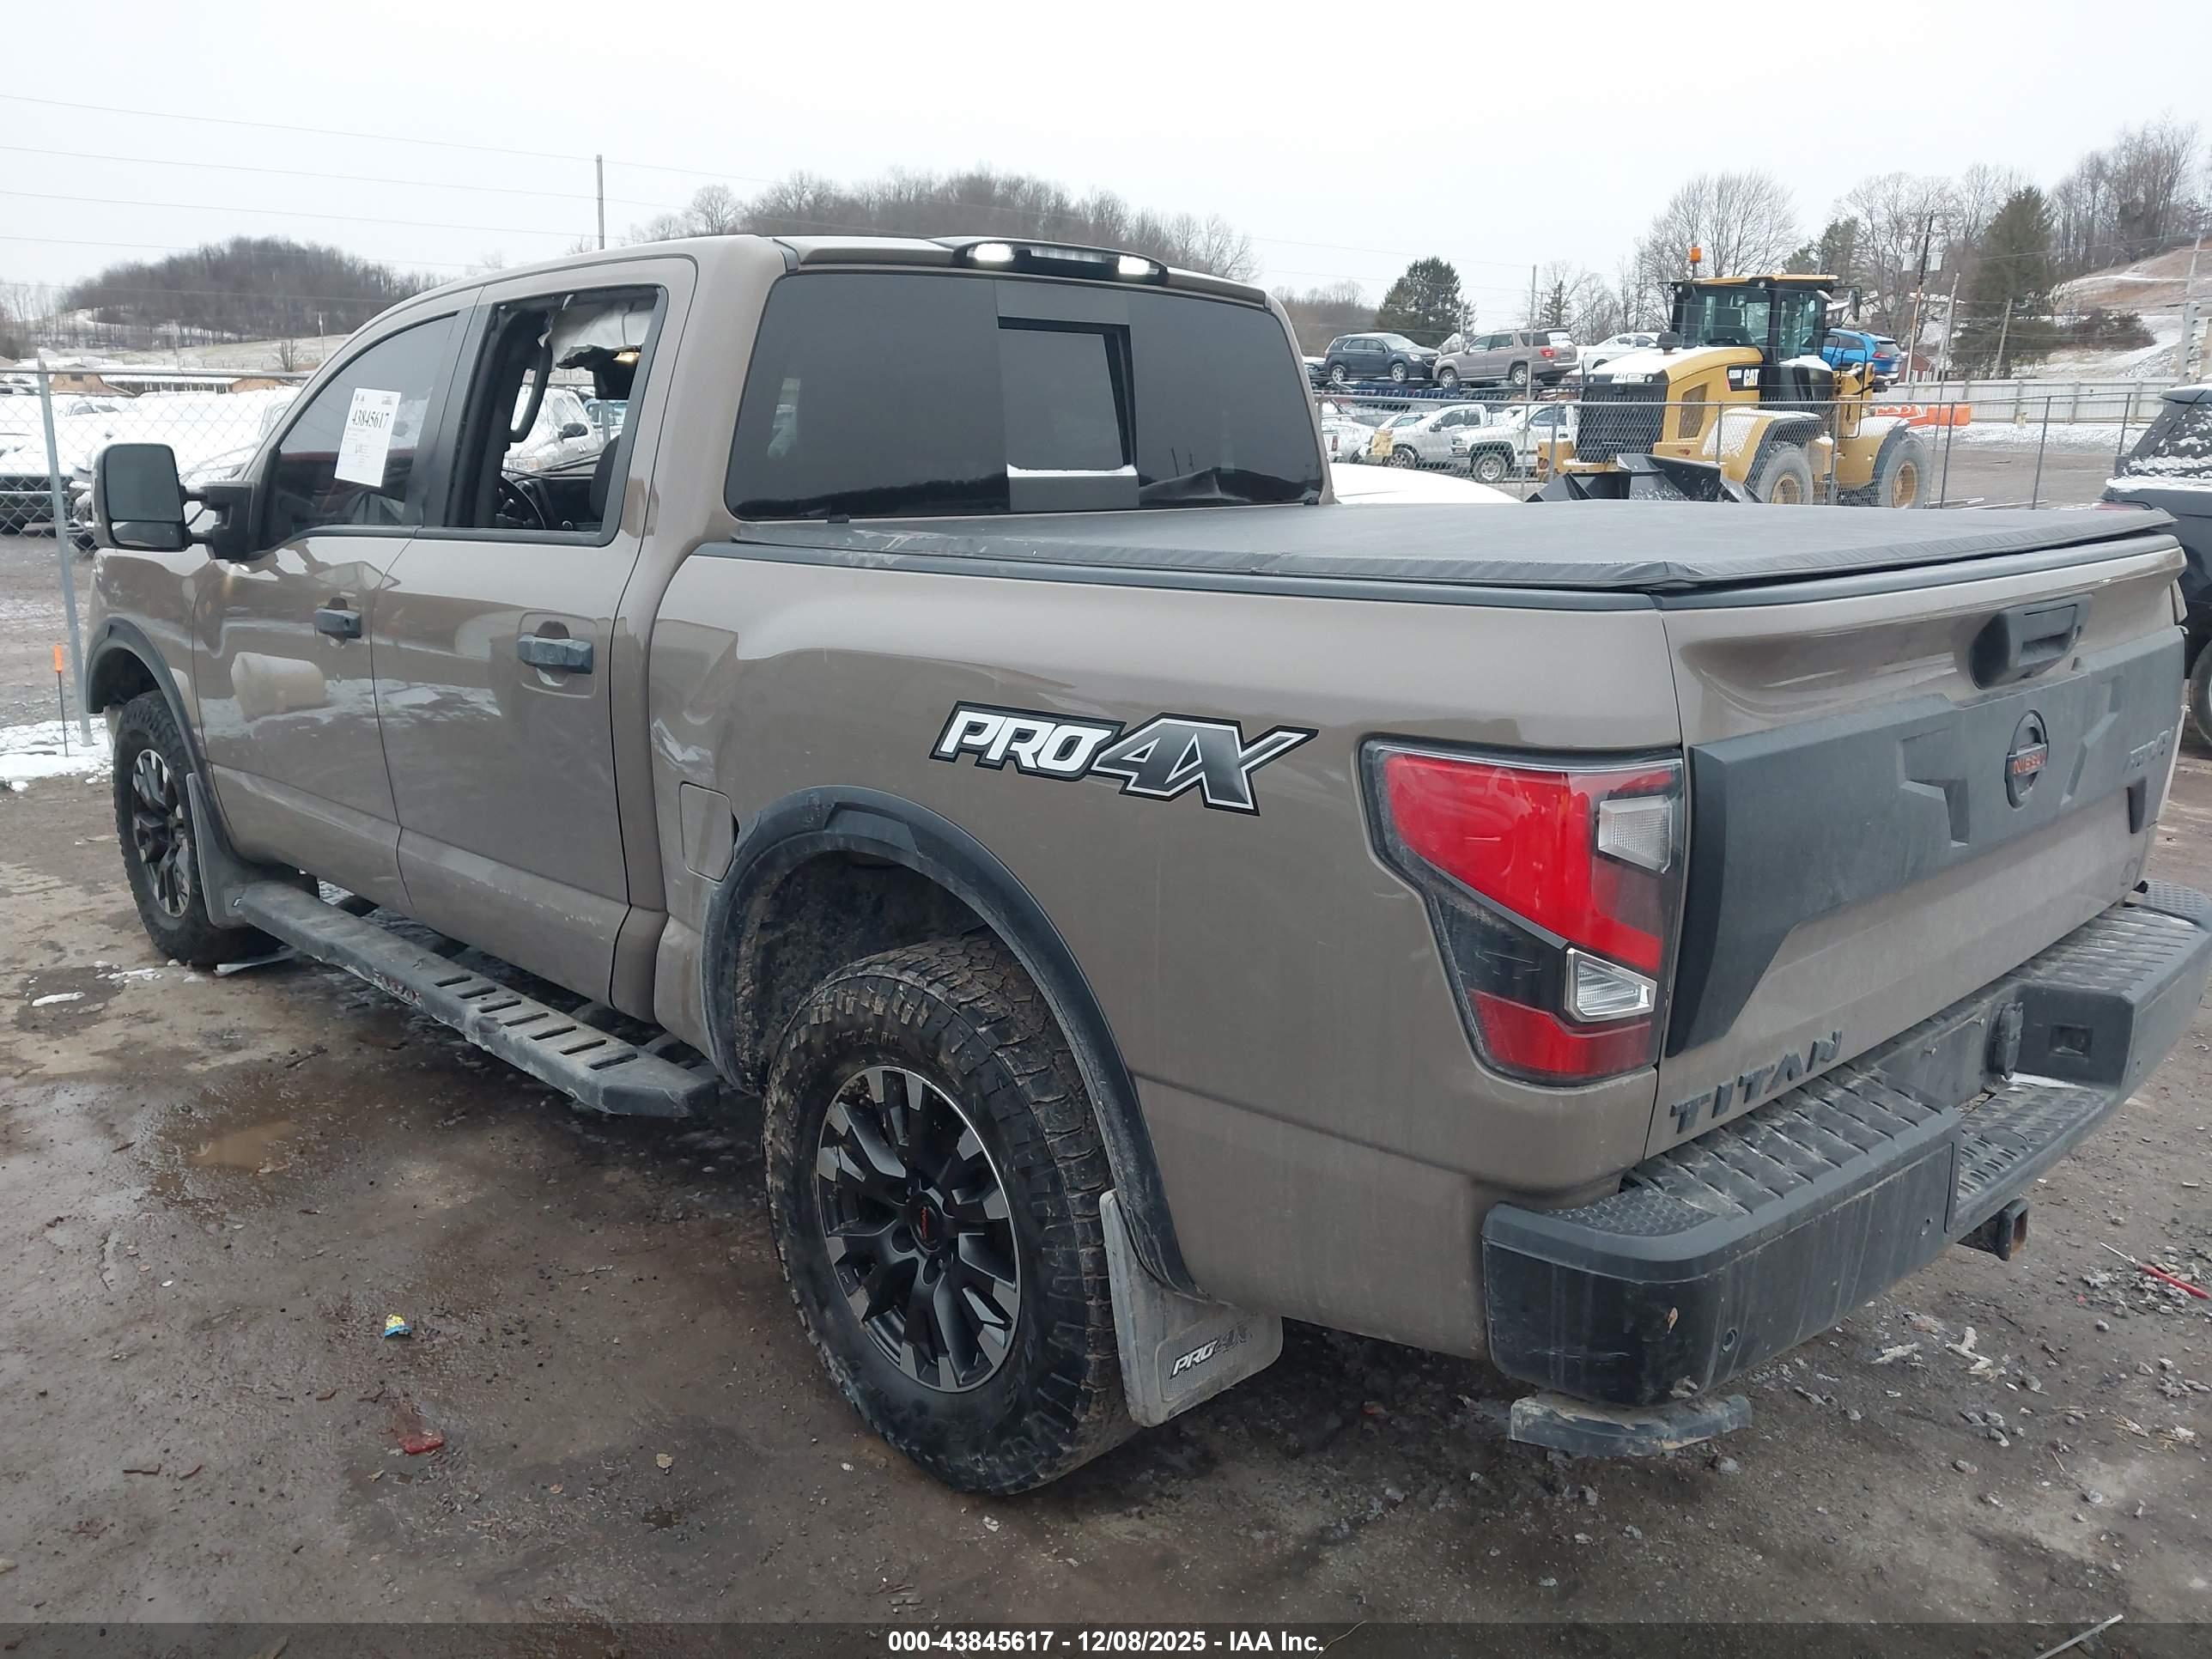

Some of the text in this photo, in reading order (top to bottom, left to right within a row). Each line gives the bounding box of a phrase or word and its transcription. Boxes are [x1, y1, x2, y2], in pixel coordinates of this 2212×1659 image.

[1743, 368, 1759, 386] CAT
[352, 409, 390, 428] 43845617
[1670, 1030, 1843, 1134] TITAN
